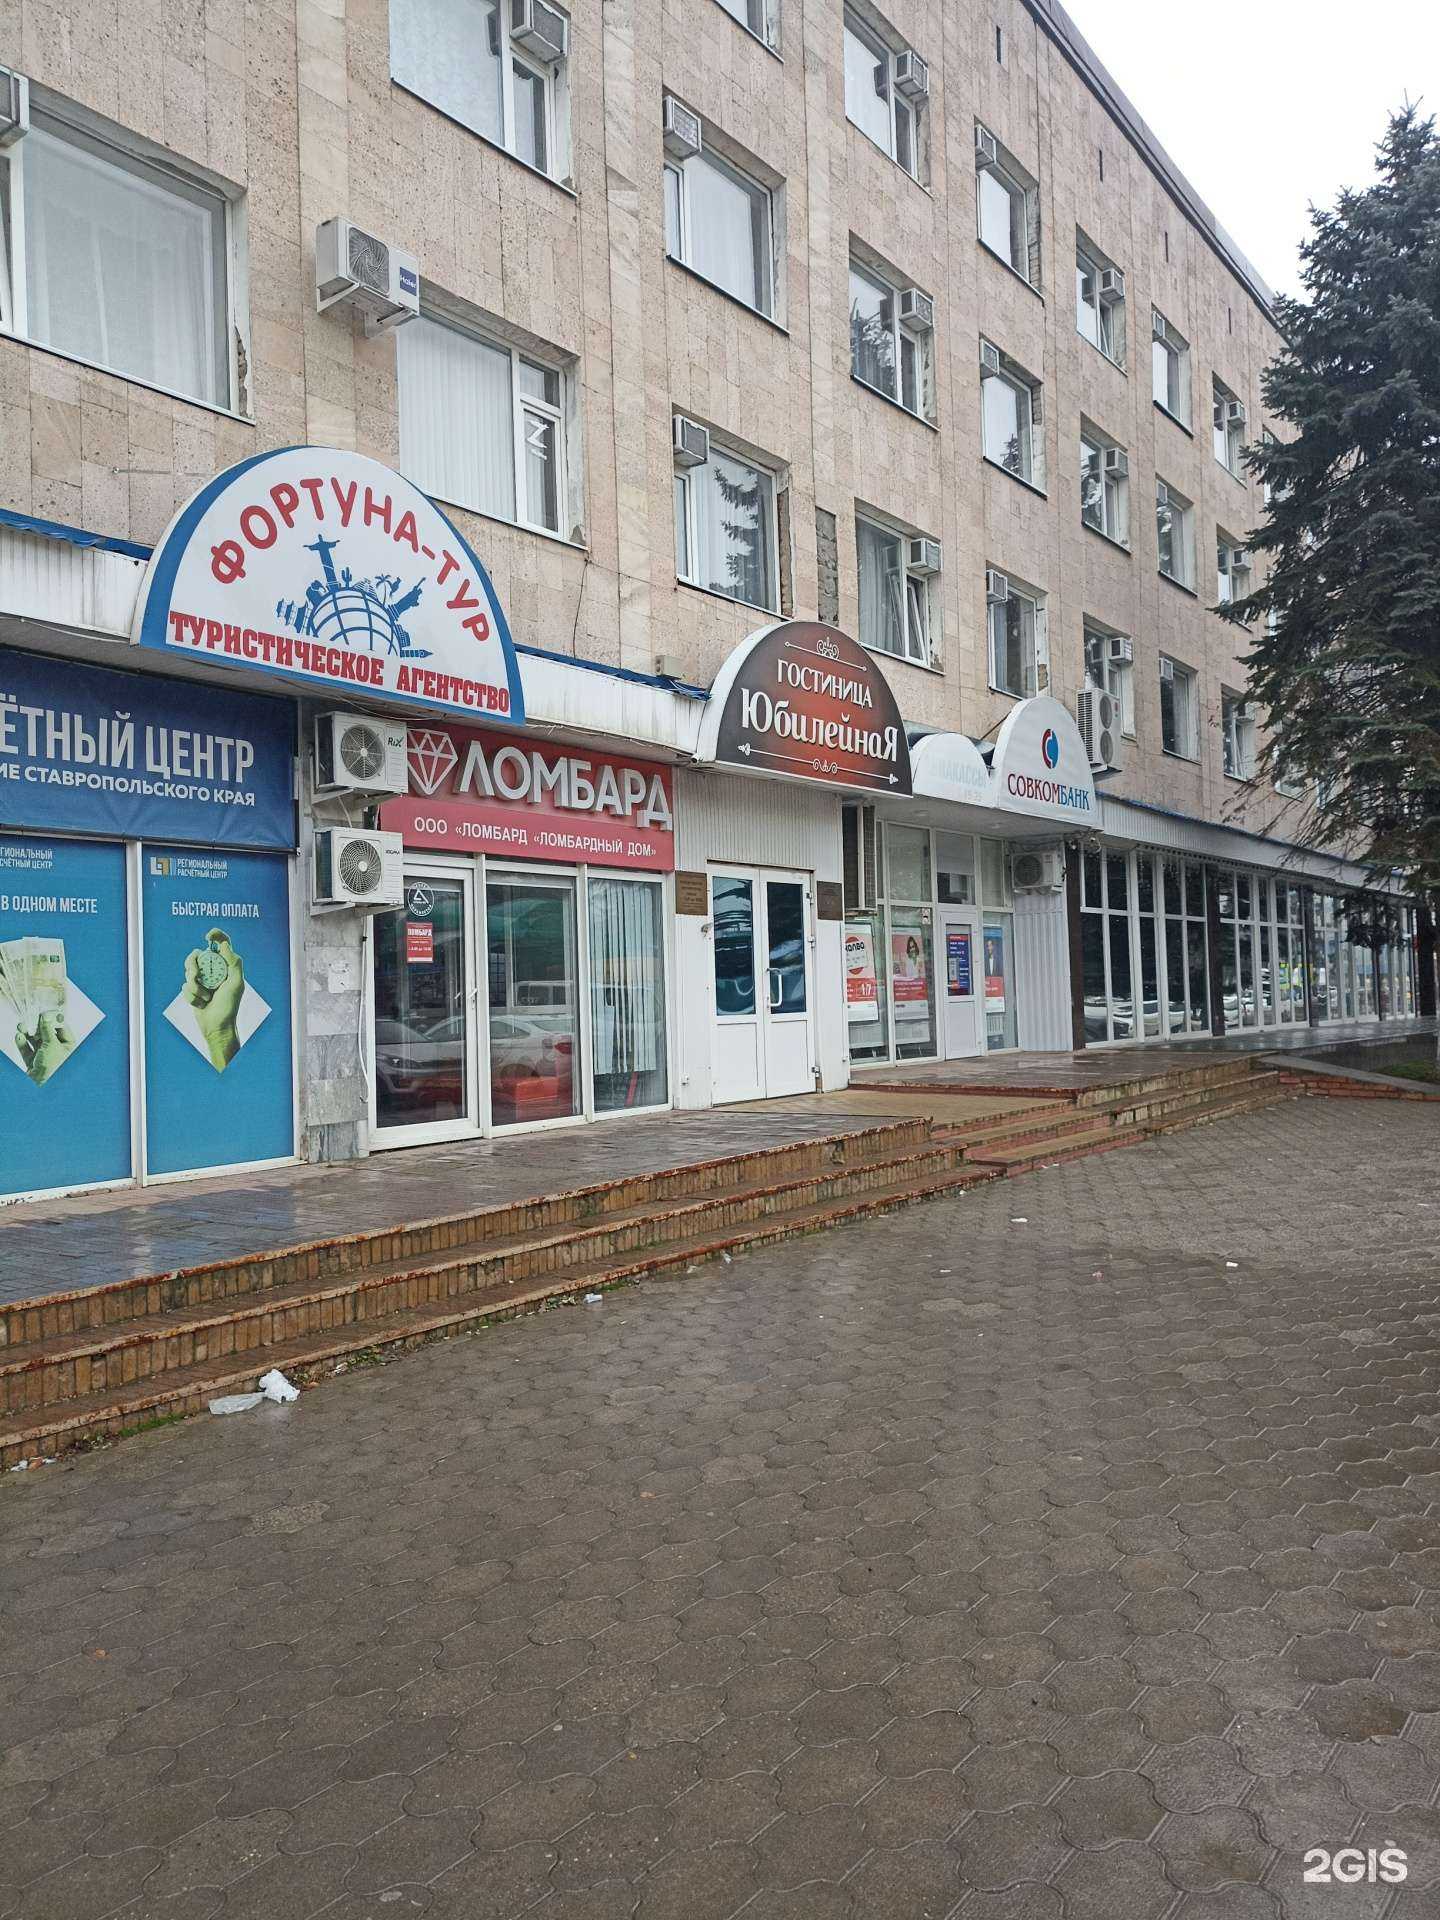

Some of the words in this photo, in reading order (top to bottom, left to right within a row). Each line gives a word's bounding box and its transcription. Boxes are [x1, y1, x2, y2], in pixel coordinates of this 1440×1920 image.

[211, 477, 489, 642] ФОРТУНА-ТУР
[170, 610, 385, 686] ТУРИСТИЧЕСКОЕ
[396, 664, 510, 713] АГЕНТСТВО
[777, 658, 873, 709] ГОСТИНИЦА
[145, 724, 254, 784] ЦЕНТР
[24, 766, 211, 802] СТАВРОПОЛЬСКОГО
[213, 788, 255, 807] КРАЯ
[459, 739, 673, 831] ЛОМБАРД
[1007, 773, 1090, 811] СОВКОМБАНК
[414, 816, 448, 834] ООО
[455, 822, 528, 845] «ЛОМБАРД
[533, 832, 623, 854] «ЛОМБАРДНЫЙ
[627, 842, 656, 857] ДОМ»
[177, 858, 228, 870] РЕГИОНАЛЬНЫЙ
[1, 895, 9, 911] В
[12, 896, 57, 912] ОДНОМ
[60, 897, 98, 914] МЕСТЕ
[172, 901, 219, 917] БЫСТРАЯ
[221, 903, 260, 918] ОПЛАТА
